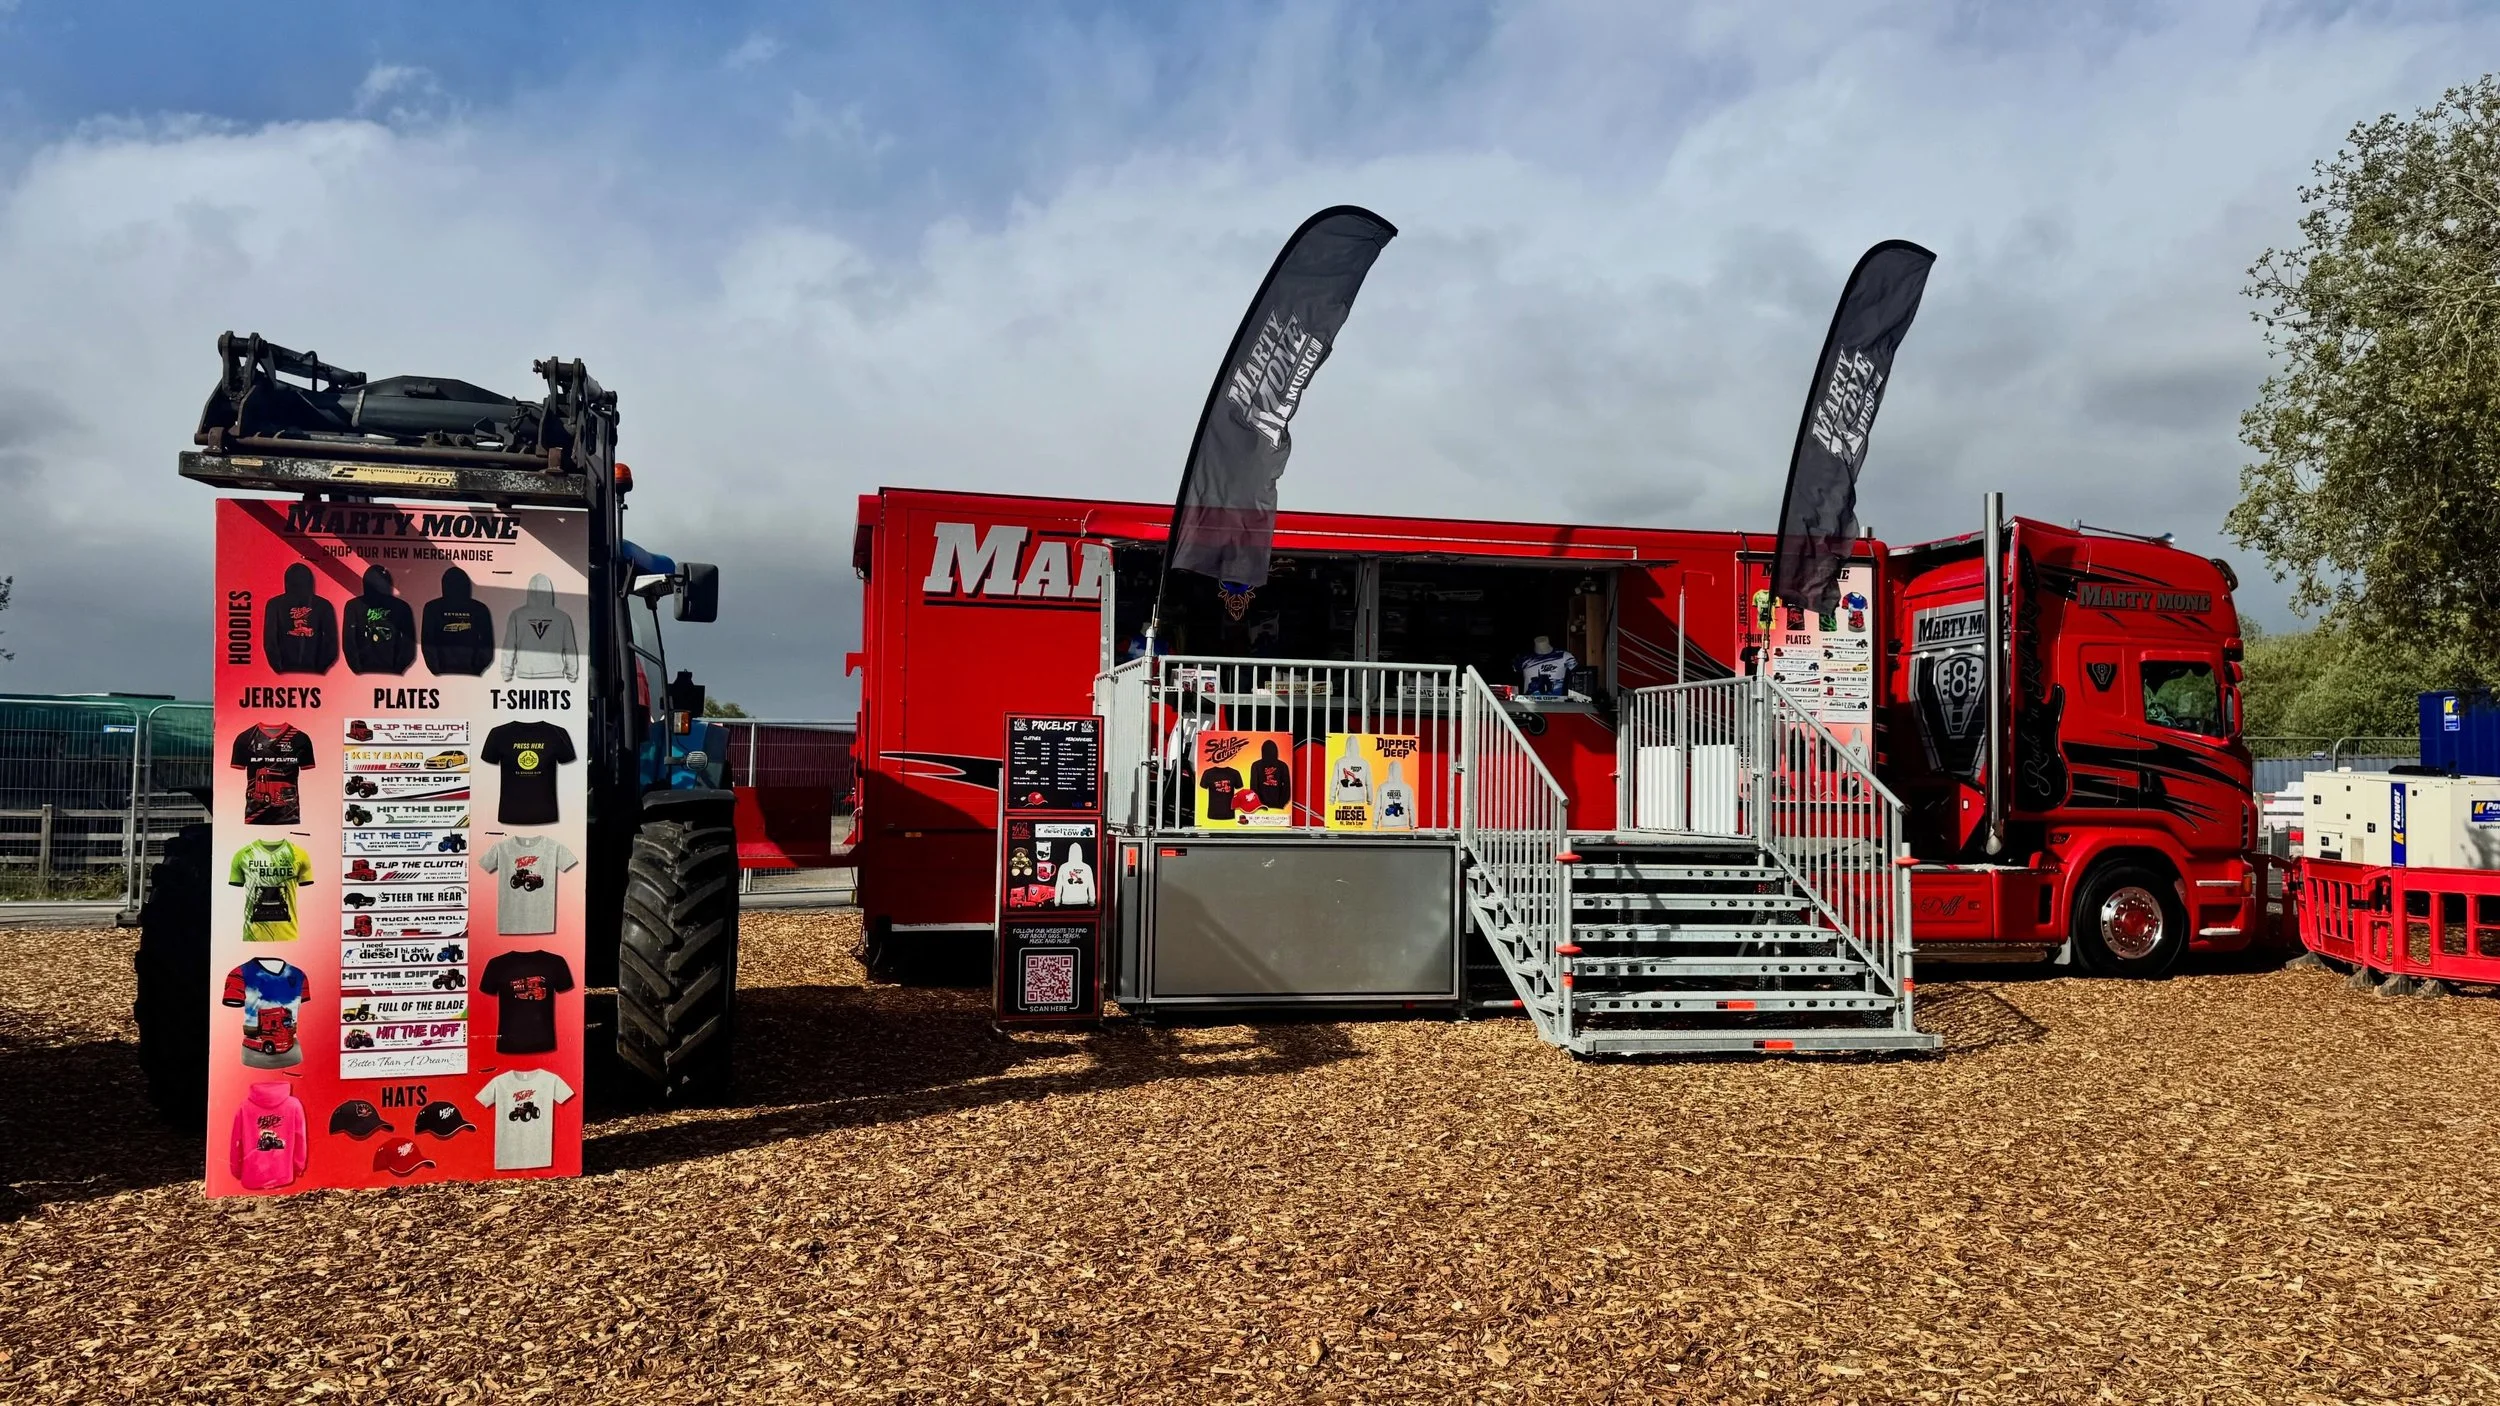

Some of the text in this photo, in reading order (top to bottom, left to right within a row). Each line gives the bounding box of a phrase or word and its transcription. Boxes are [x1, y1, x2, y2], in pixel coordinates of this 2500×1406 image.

[1227, 309, 1282, 418] MARTY
[1246, 313, 1306, 447] MONE
[1286, 349, 1318, 400] MUSIC
[1812, 349, 1852, 449] MARTY
[284, 504, 521, 539] MARTY MONE
[322, 545, 494, 561] SHOP OUR NEW MERCHANDISE
[2080, 585, 2213, 612] MARTY MONE
[228, 590, 251, 665] HOODIES
[1919, 615, 1966, 643] MARTY
[1786, 635, 1811, 645] PLATES
[1951, 660, 1968, 698] 8
[239, 687, 321, 708] JERSEYS
[374, 688, 440, 709] PLATES
[490, 689, 571, 710] T-SHIRTS
[1031, 720, 1078, 731] PRICELIST
[1205, 737, 1239, 753] SLIP
[1376, 737, 1417, 752] DIPPER
[351, 752, 423, 760] KEYBANG
[1211, 746, 1240, 763] CLUTCH
[1384, 749, 1409, 759] DEEP
[2020, 731, 2050, 797] Rock
[1335, 810, 1367, 821] DIESEL
[2474, 802, 2485, 814] K
[2393, 789, 2404, 845] K Power
[259, 868, 293, 877] BLADE
[380, 892, 462, 902] STEER THE REAR
[360, 948, 398, 959] diesel
[401, 953, 434, 963] LOW
[370, 971, 401, 979] THE
[405, 970, 439, 978] DIFF
[377, 1000, 464, 1012] FULL OF THE BLADE
[376, 1026, 399, 1039] HIT
[400, 1025, 427, 1039] THE
[430, 1023, 461, 1038] DIFF
[347, 1055, 449, 1068] Better Than A Dream
[382, 1085, 427, 1108] HATS
